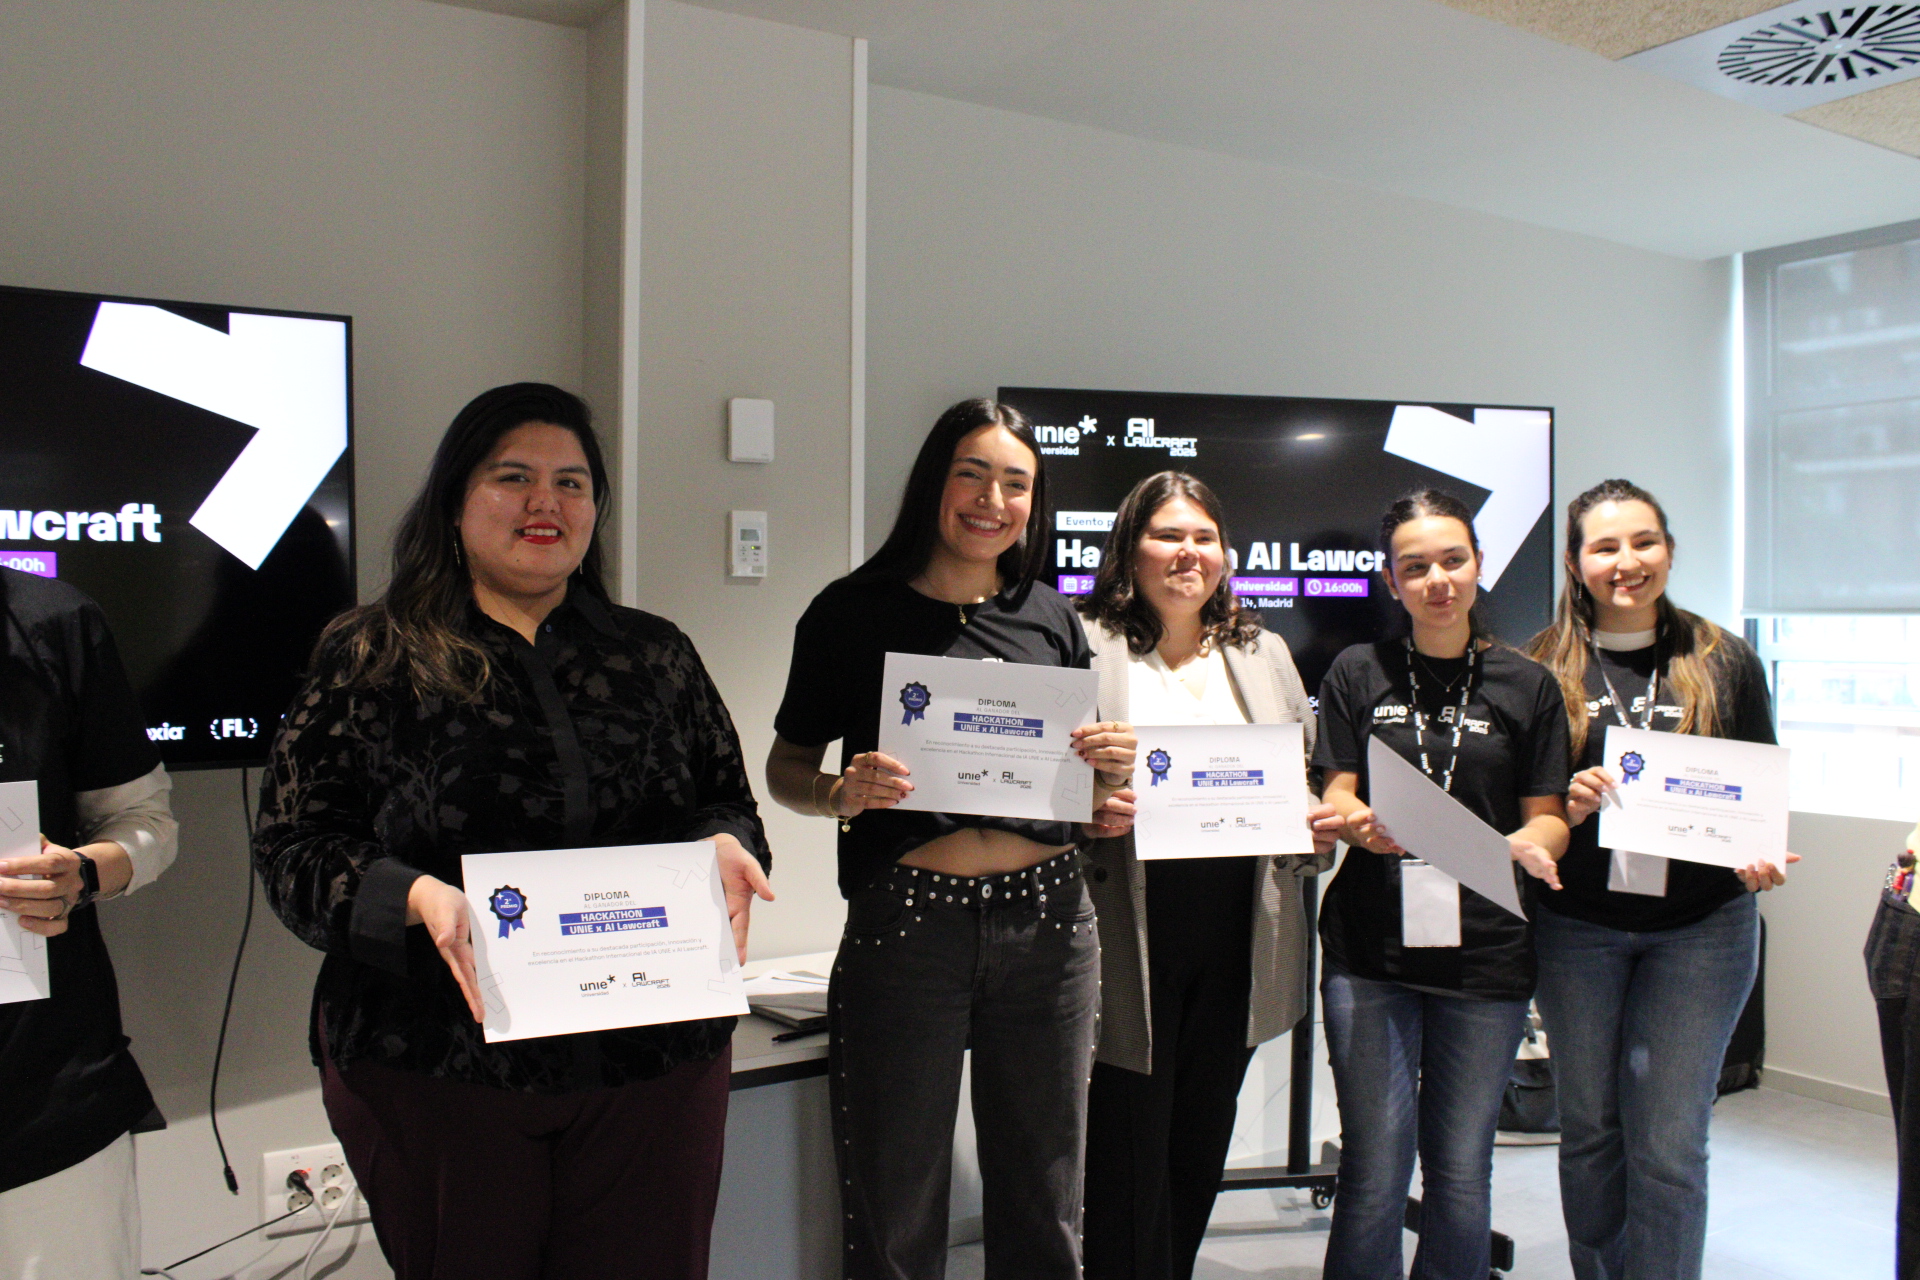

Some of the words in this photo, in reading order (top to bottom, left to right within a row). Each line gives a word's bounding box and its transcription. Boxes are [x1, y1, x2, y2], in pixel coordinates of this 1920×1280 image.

[1127, 418, 1155, 437] AI
[1124, 436, 1197, 448] LAWCRAFT
[1040, 446, 1079, 456] versidad
[1169, 448, 1197, 457] 2026
[0, 503, 162, 542] wcraft
[1066, 516, 1104, 526] Evento
[1246, 541, 1281, 570] AI
[1290, 542, 1386, 572] Lawcr
[0, 557, 46, 572] :00h
[1324, 582, 1363, 593] 16:00h
[1258, 597, 1293, 608] Madrid
[978, 698, 1016, 708] DIPLOMA
[1373, 705, 1408, 717] unie
[972, 715, 1024, 726] HACKATHON
[222, 718, 248, 737] FL
[960, 724, 980, 732] UNIE
[989, 726, 998, 734] AI
[1000, 727, 1036, 737] Lawcraft
[1210, 756, 1240, 764] DIPLOMA
[1002, 771, 1014, 780] AI
[1686, 766, 1719, 776] DIPLOMA
[1680, 780, 1725, 791] HACKATHON
[584, 891, 630, 902] DIPLOMA
[581, 910, 643, 922] HACKATHON
[570, 924, 593, 934] UNIE
[604, 923, 615, 932] AI
[616, 919, 661, 930] Lawcraft
[541, 948, 586, 956] reconocimiento
[600, 944, 628, 952] destacada
[632, 972, 646, 982] AI
[632, 979, 670, 987] LAWCRAFT
